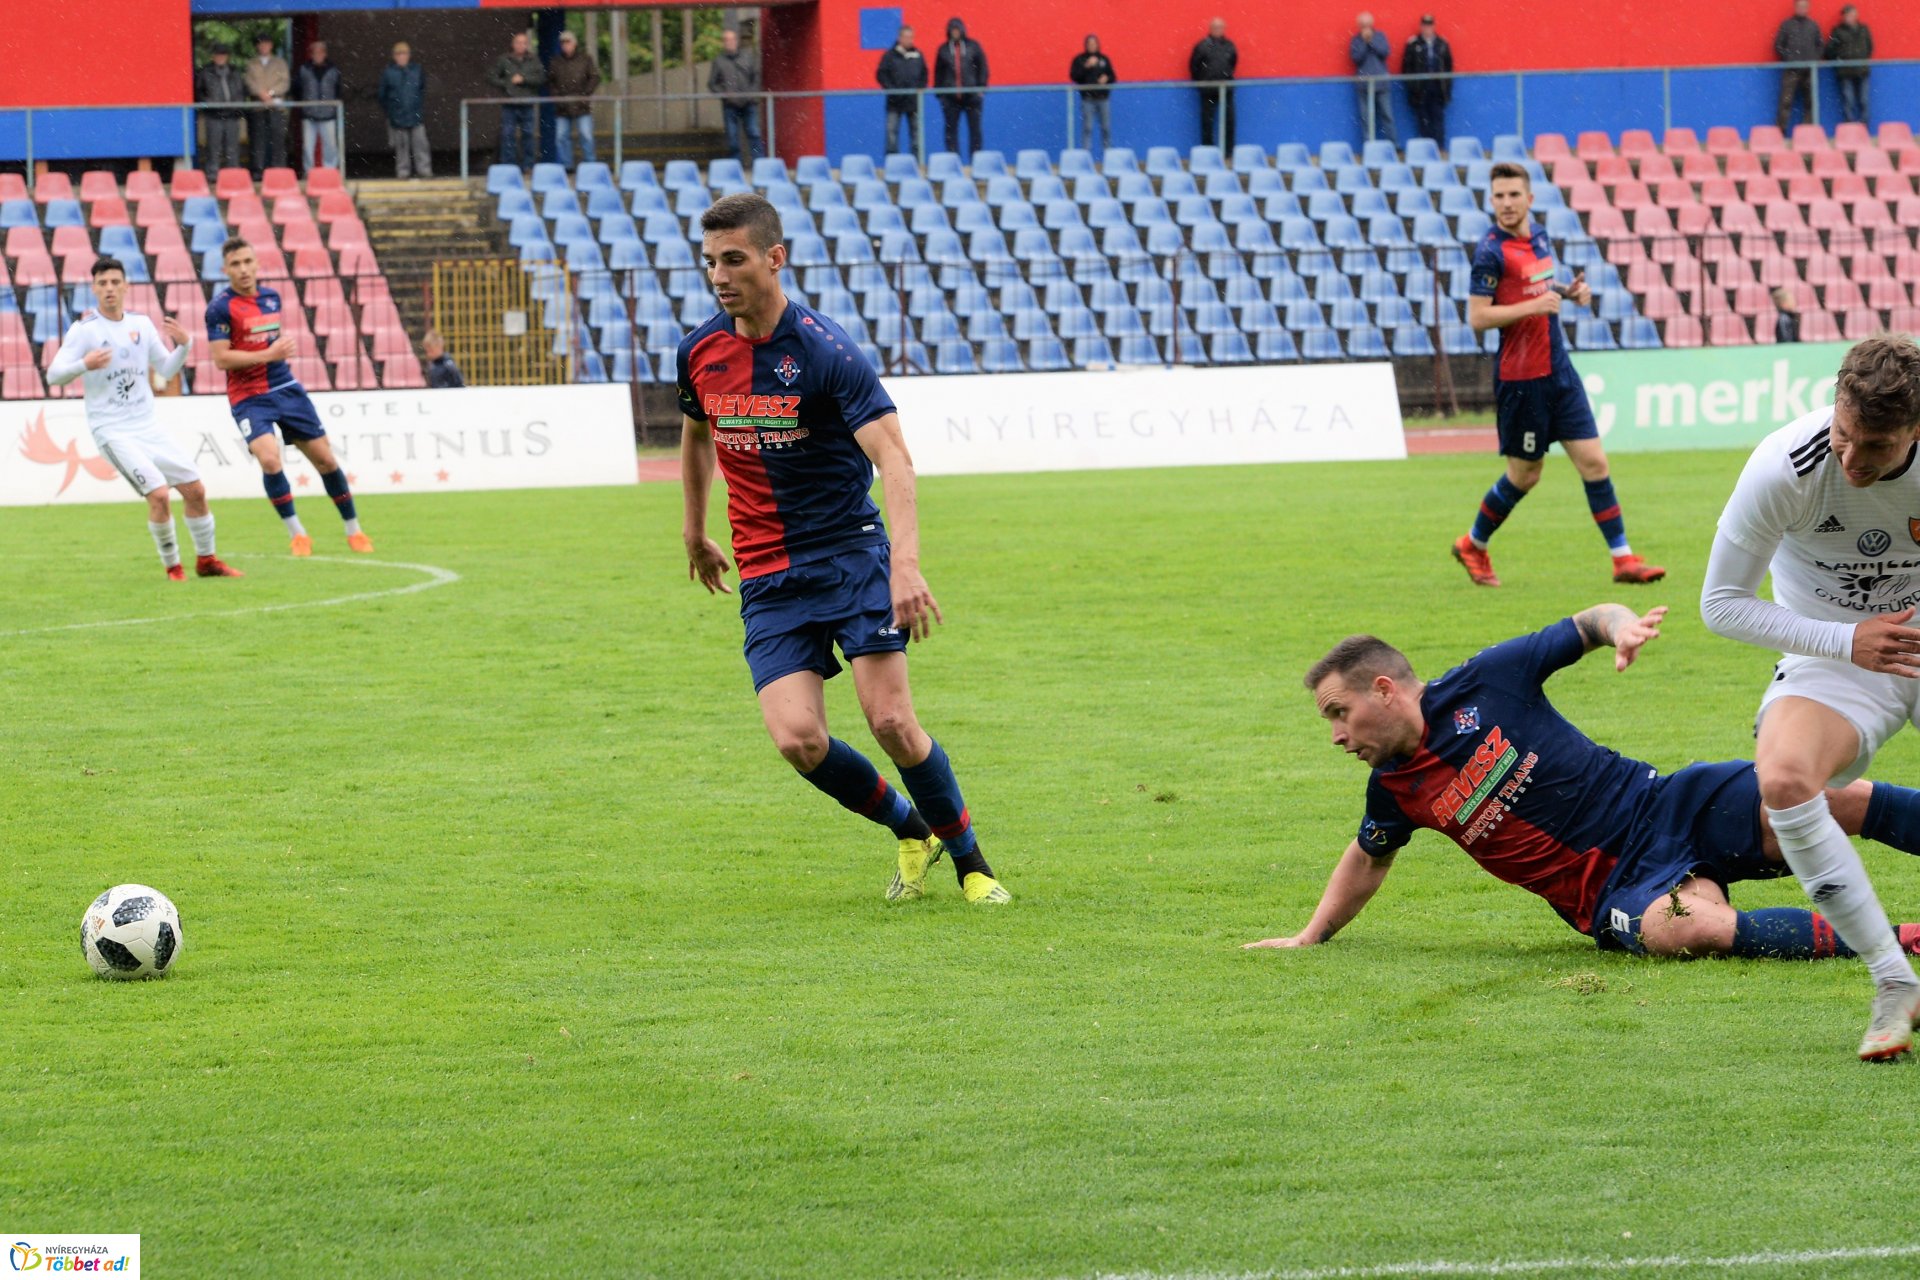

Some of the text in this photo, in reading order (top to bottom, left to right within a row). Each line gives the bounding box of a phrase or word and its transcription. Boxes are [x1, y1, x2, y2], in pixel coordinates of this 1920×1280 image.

[329, 402, 431, 417] OTEL
[946, 400, 1354, 442] NYÍREGYHÁZA
[1523, 431, 1536, 453] 6
[133, 468, 146, 485] 6
[1498, 751, 1539, 800] TRANS
